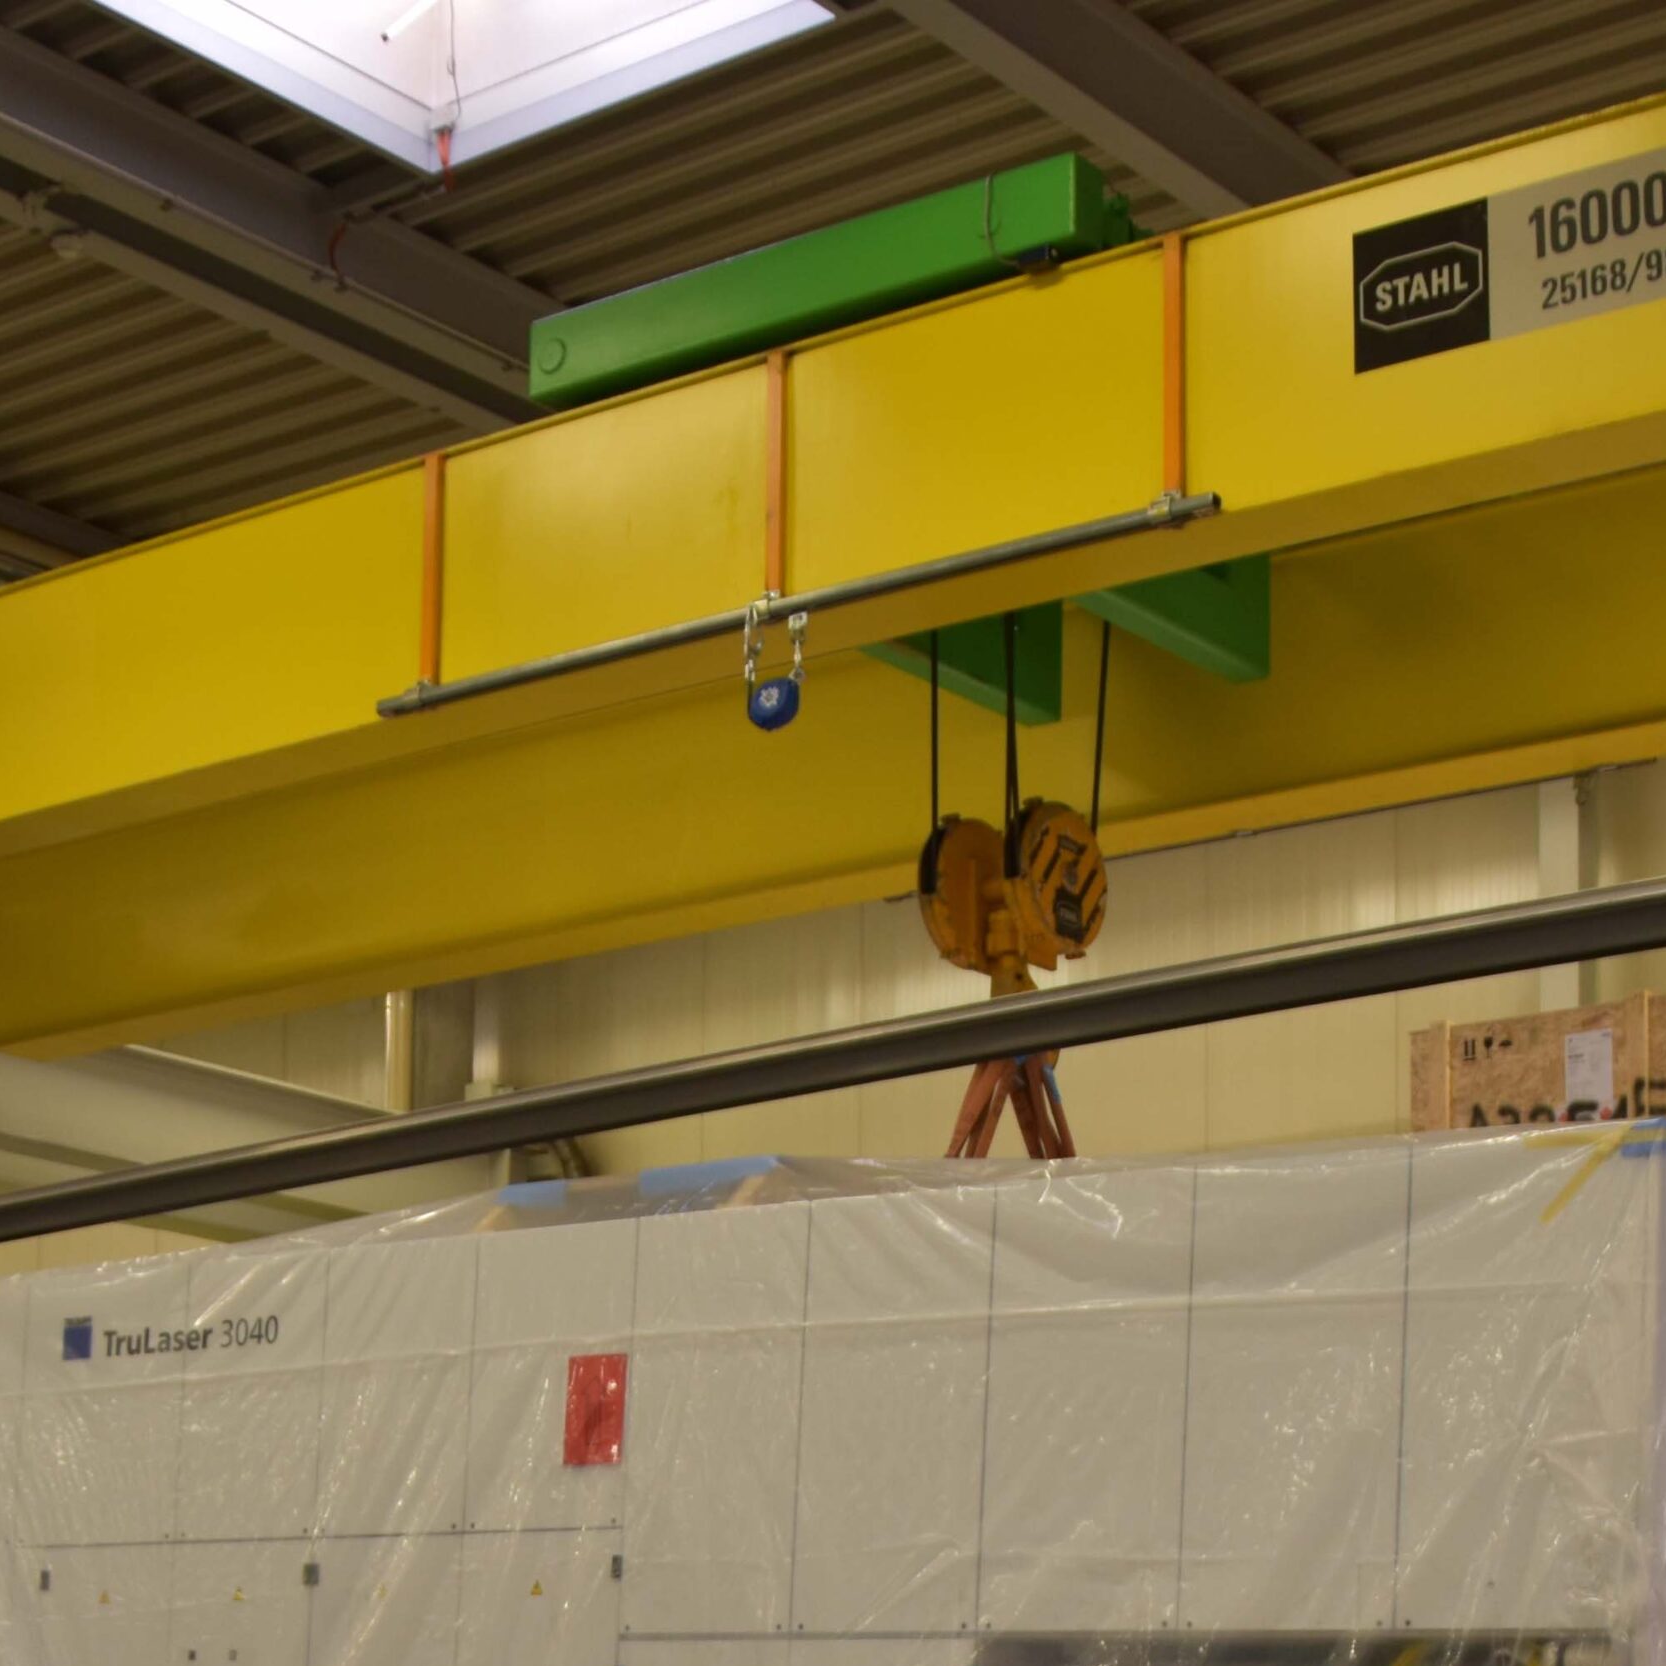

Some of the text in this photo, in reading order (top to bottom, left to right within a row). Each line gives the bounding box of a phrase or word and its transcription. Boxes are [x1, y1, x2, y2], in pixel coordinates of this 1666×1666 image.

[1375, 262, 1468, 313] STAHL
[103, 1315, 279, 1357] TruLaser 3040
